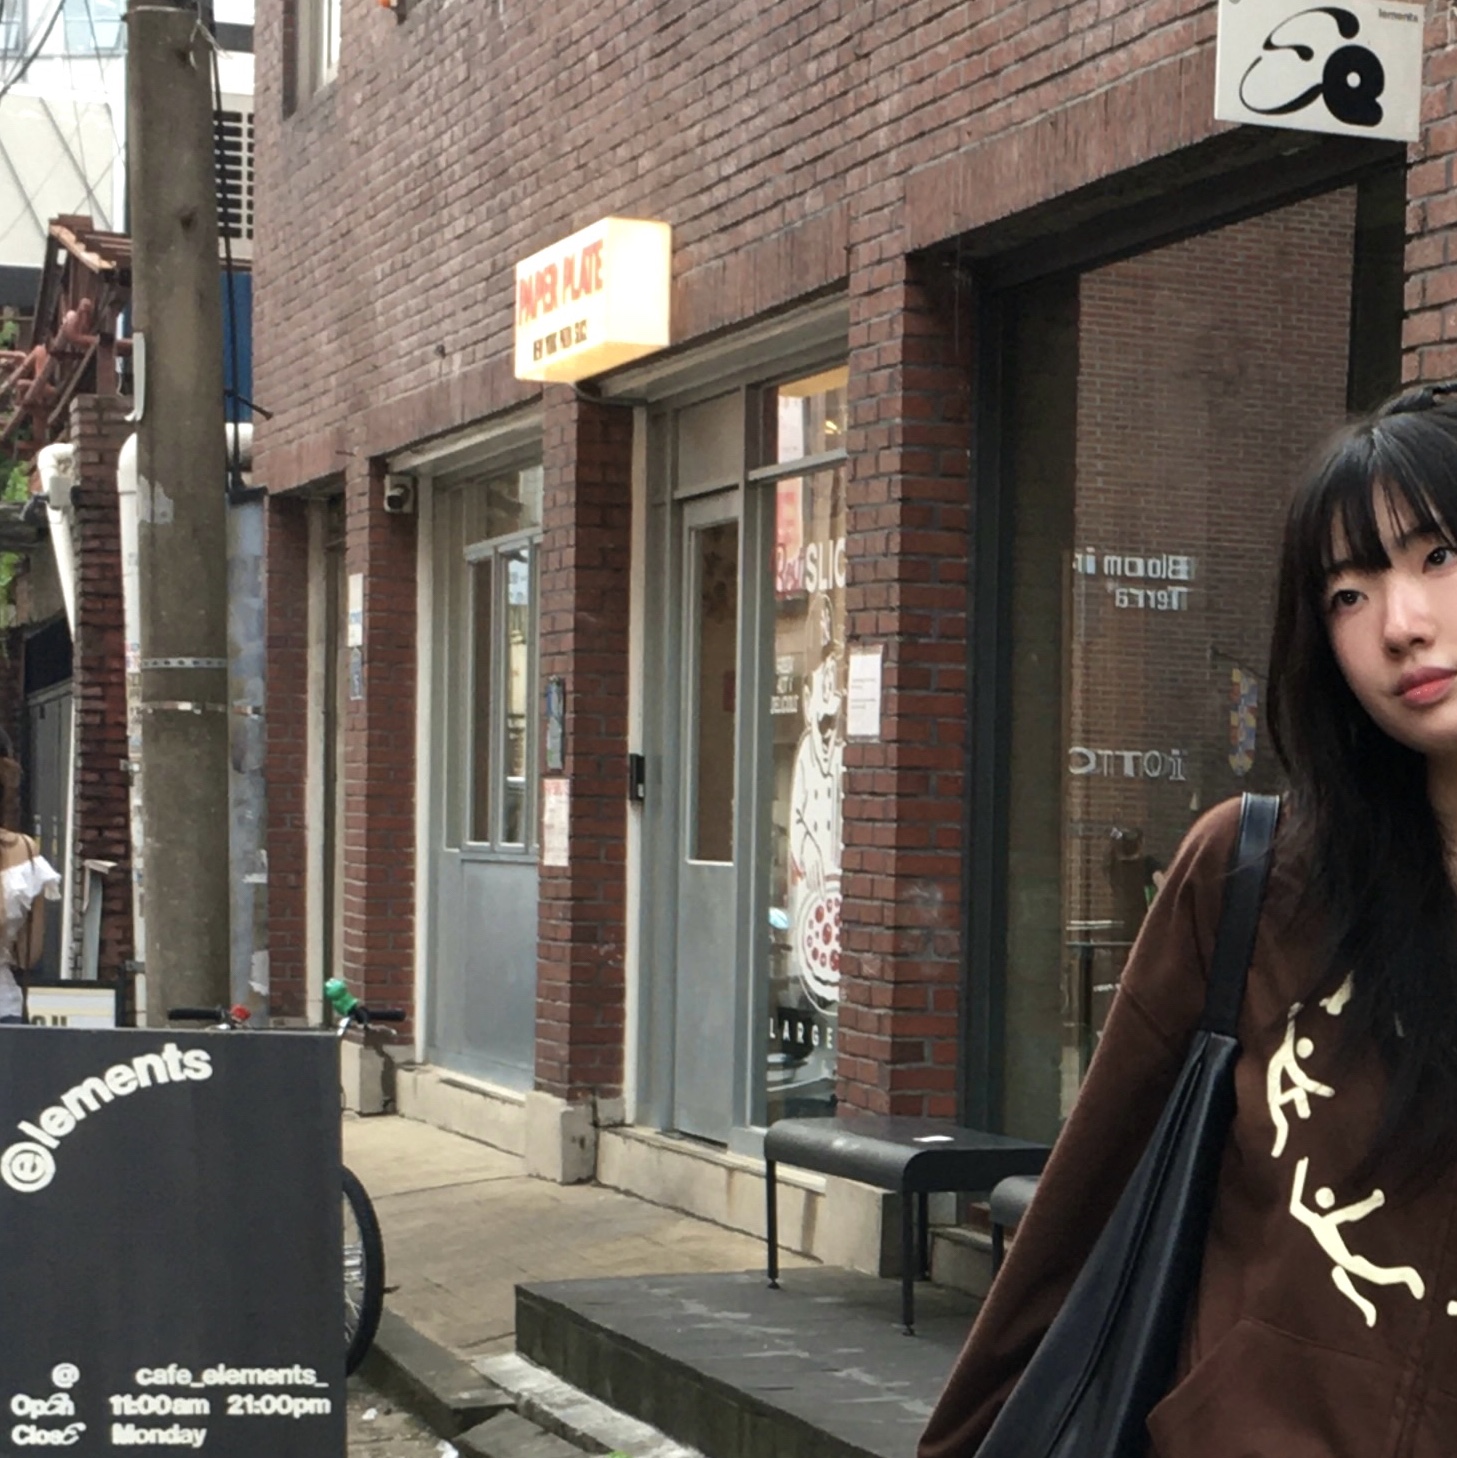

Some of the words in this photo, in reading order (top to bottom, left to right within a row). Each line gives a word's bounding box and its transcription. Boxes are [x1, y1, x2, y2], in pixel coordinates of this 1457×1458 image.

[769, 1017, 834, 1049] LARGE
[10, 1393, 75, 1419] Open
[226, 1394, 332, 1419] 21:00pm
[11, 1422, 86, 1446] Close
[111, 1423, 207, 1448] Monday
